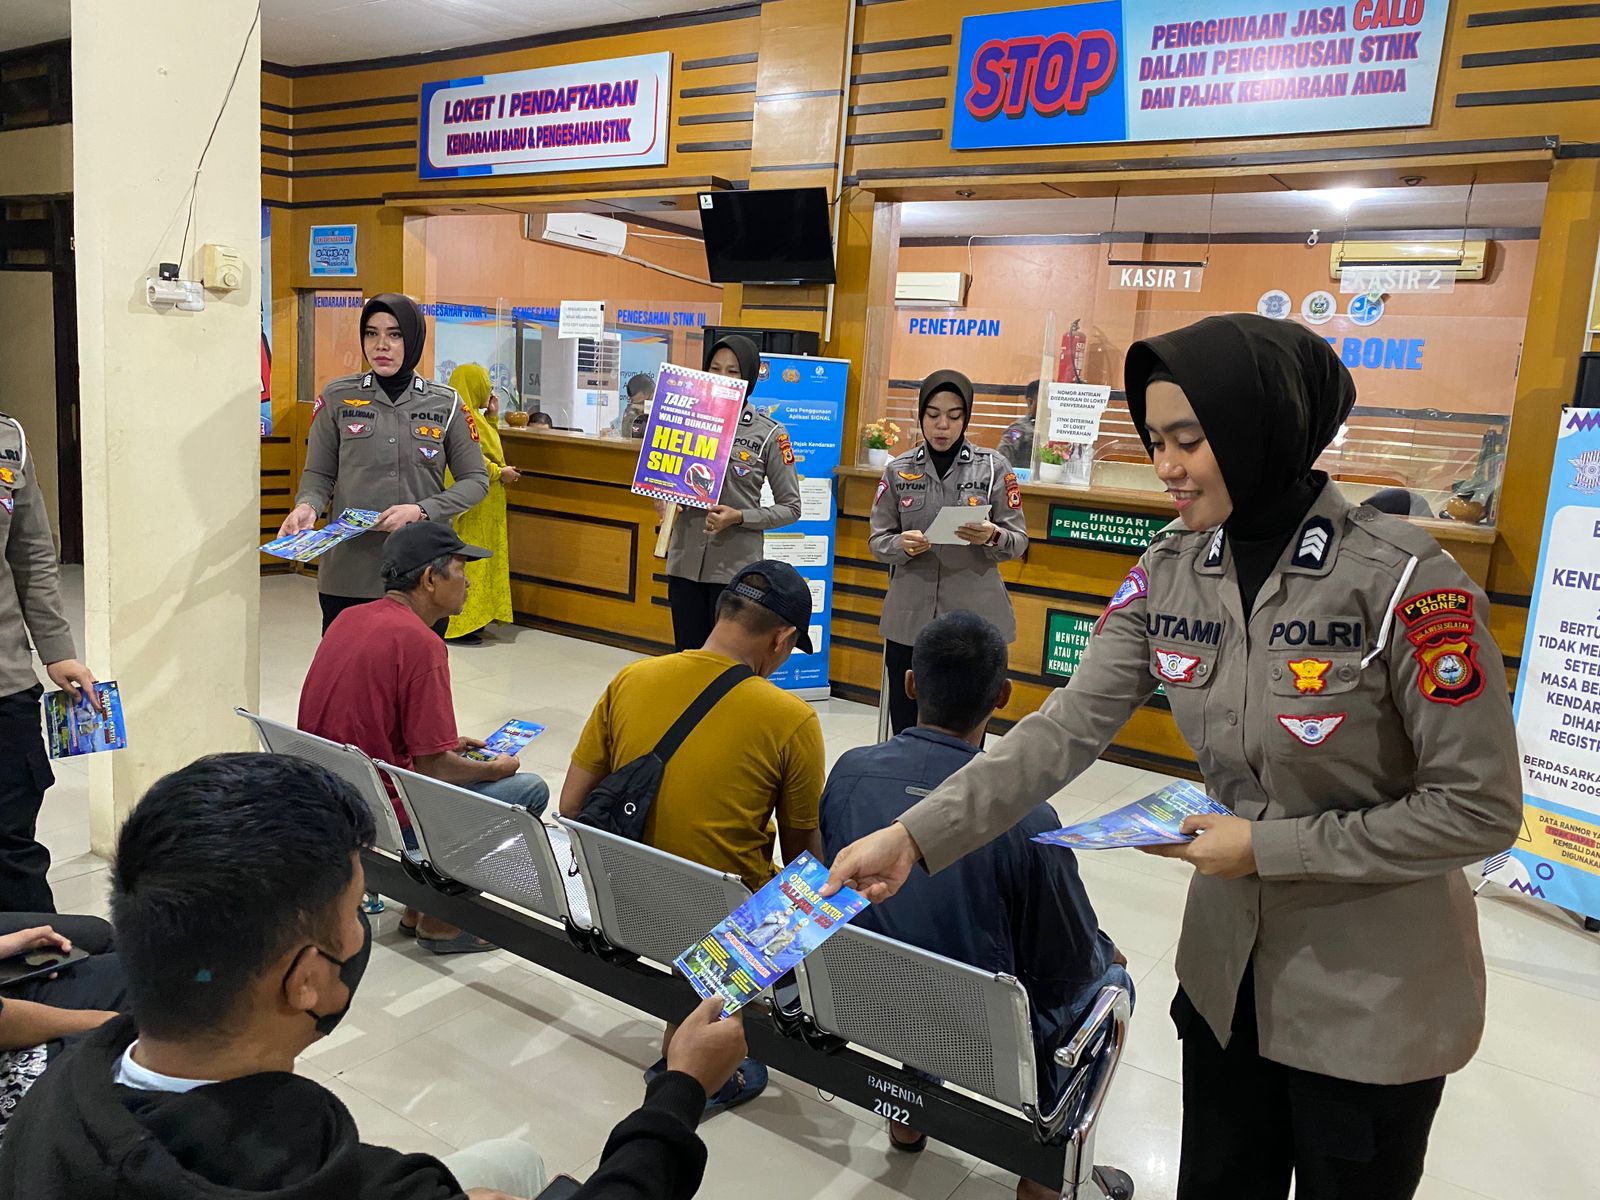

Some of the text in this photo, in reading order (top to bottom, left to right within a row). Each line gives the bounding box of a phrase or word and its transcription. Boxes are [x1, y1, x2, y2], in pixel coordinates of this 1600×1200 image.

[1151, 0, 1424, 50] PENGGUNAAN JASA CALO
[1139, 32, 1421, 82] DALAM PENGURUSAN STNK
[965, 30, 1118, 117] STOP
[1140, 69, 1407, 110] DAN PAJAK KENDARAAN ANDA
[444, 96, 496, 124] LOKET
[509, 79, 639, 117] PENDAFTARAN
[447, 118, 632, 156] KENDARAAN BARU & PENGESAHAN STNK
[1120, 268, 1191, 289] KASIR 1
[1354, 269, 1442, 290] KASIR 2
[617, 309, 671, 326] PENGESAHAN
[673, 311, 695, 326] STNK
[909, 317, 1001, 338] PENETAPAN
[1340, 337, 1426, 370] BONE
[1057, 389, 1077, 397] NOMOR
[410, 413, 443, 424] POLRI
[659, 412, 724, 434] WAJIB GUNAKAN
[651, 425, 720, 461] HELM
[734, 438, 761, 453] POLRI
[647, 451, 683, 476] SNI
[1055, 519, 1144, 537] PENGURUSAN
[1089, 513, 1150, 527] HINDARI
[1070, 531, 1127, 544] MELALUI
[1404, 593, 1466, 615] POLRES
[1421, 602, 1456, 615] BONE
[1146, 613, 1221, 645] UTAMI
[1269, 621, 1361, 648] POLRI
[1054, 646, 1071, 658] ATAU
[1539, 634, 1600, 658] TIDAK ME
[1049, 659, 1072, 673] KEPADA
[1541, 672, 1600, 696] MASA BE
[1528, 768, 1568, 788] TAHUN
[1539, 815, 1558, 827] DATA
[1560, 821, 1591, 837] RANMOR
[1553, 838, 1584, 853] KEMBALI
[1561, 850, 1600, 869] DIGUNAKA
[789, 873, 823, 904] OPERASI
[868, 1075, 924, 1108] BAPENDA
[874, 1098, 910, 1126] 2022
